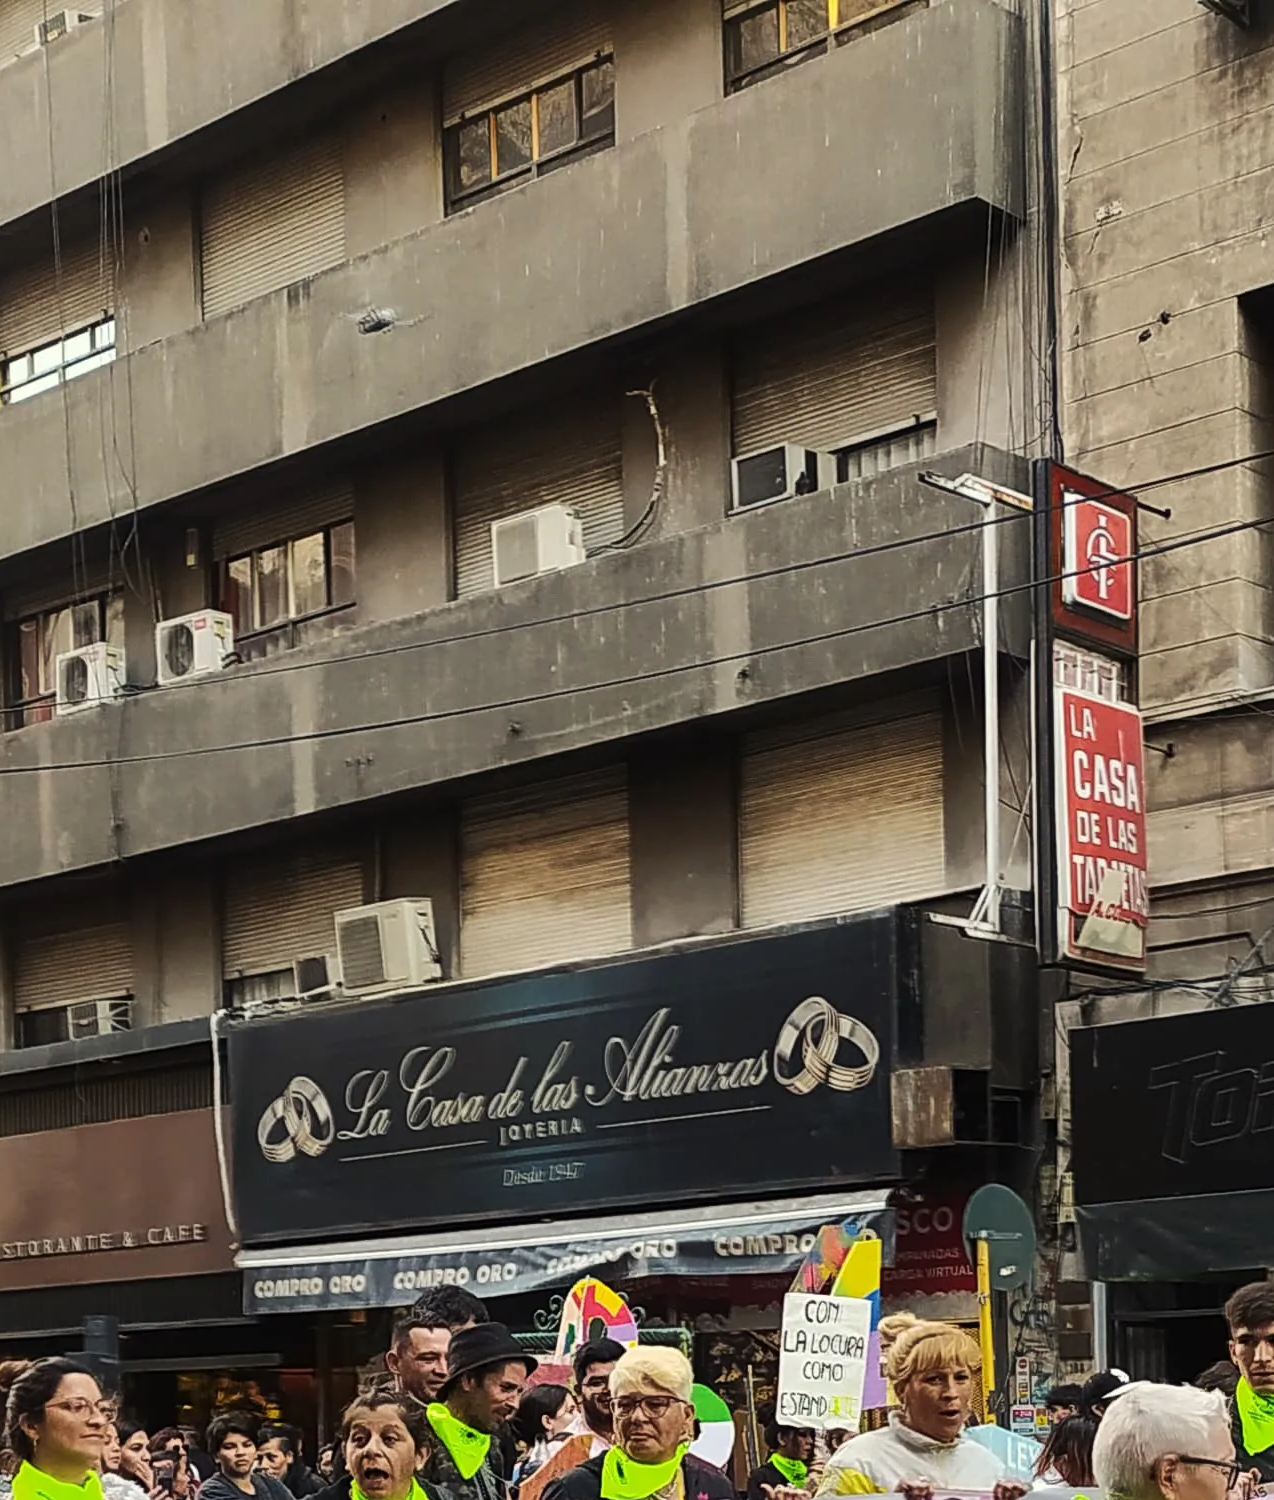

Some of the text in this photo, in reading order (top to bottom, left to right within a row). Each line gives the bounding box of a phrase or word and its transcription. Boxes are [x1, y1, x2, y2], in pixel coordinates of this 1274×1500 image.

[1069, 703, 1097, 741] LA
[1072, 750, 1142, 814] CASA
[1076, 809, 1138, 854] DE LAS
[338, 1007, 770, 1141] La Casa de las Alianzas
[122, 1231, 134, 1247] &
[714, 1233, 816, 1257] COMPRO
[254, 1273, 366, 1298] COMPRO ORO
[394, 1262, 518, 1290] COMPRO ORO
[784, 1330, 864, 1358] LA LOCURA
[803, 1360, 844, 1381] COMO
